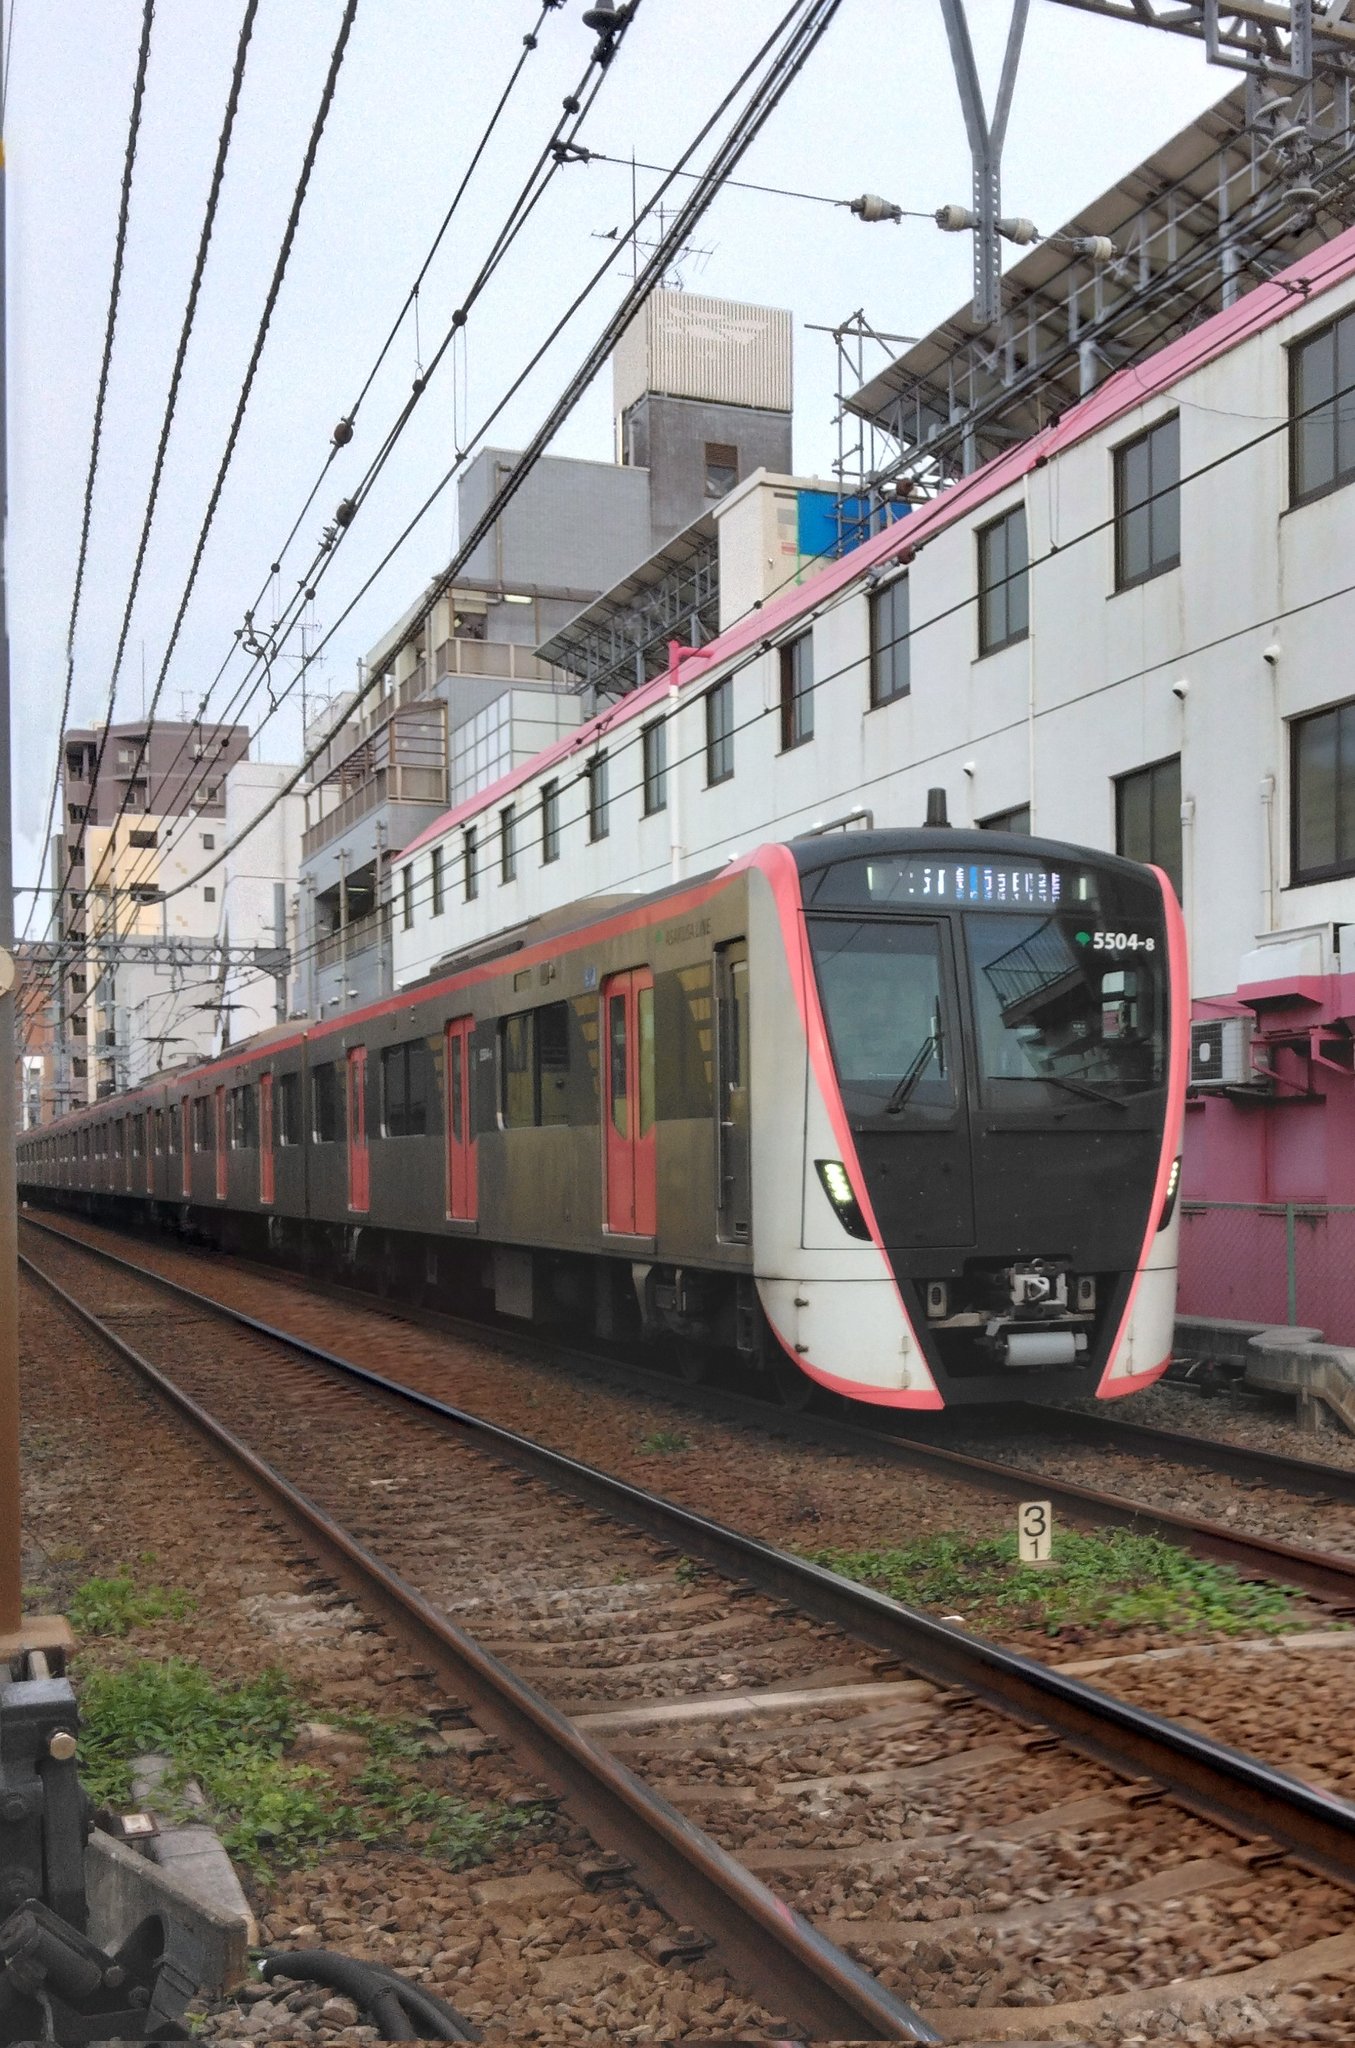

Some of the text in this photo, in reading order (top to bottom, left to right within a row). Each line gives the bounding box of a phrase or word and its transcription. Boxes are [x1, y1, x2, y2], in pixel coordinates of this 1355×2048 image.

[1093, 932, 1155, 952] 5504-8
[1023, 1505, 1046, 1537] 3
[1029, 1538, 1038, 1559] 1
